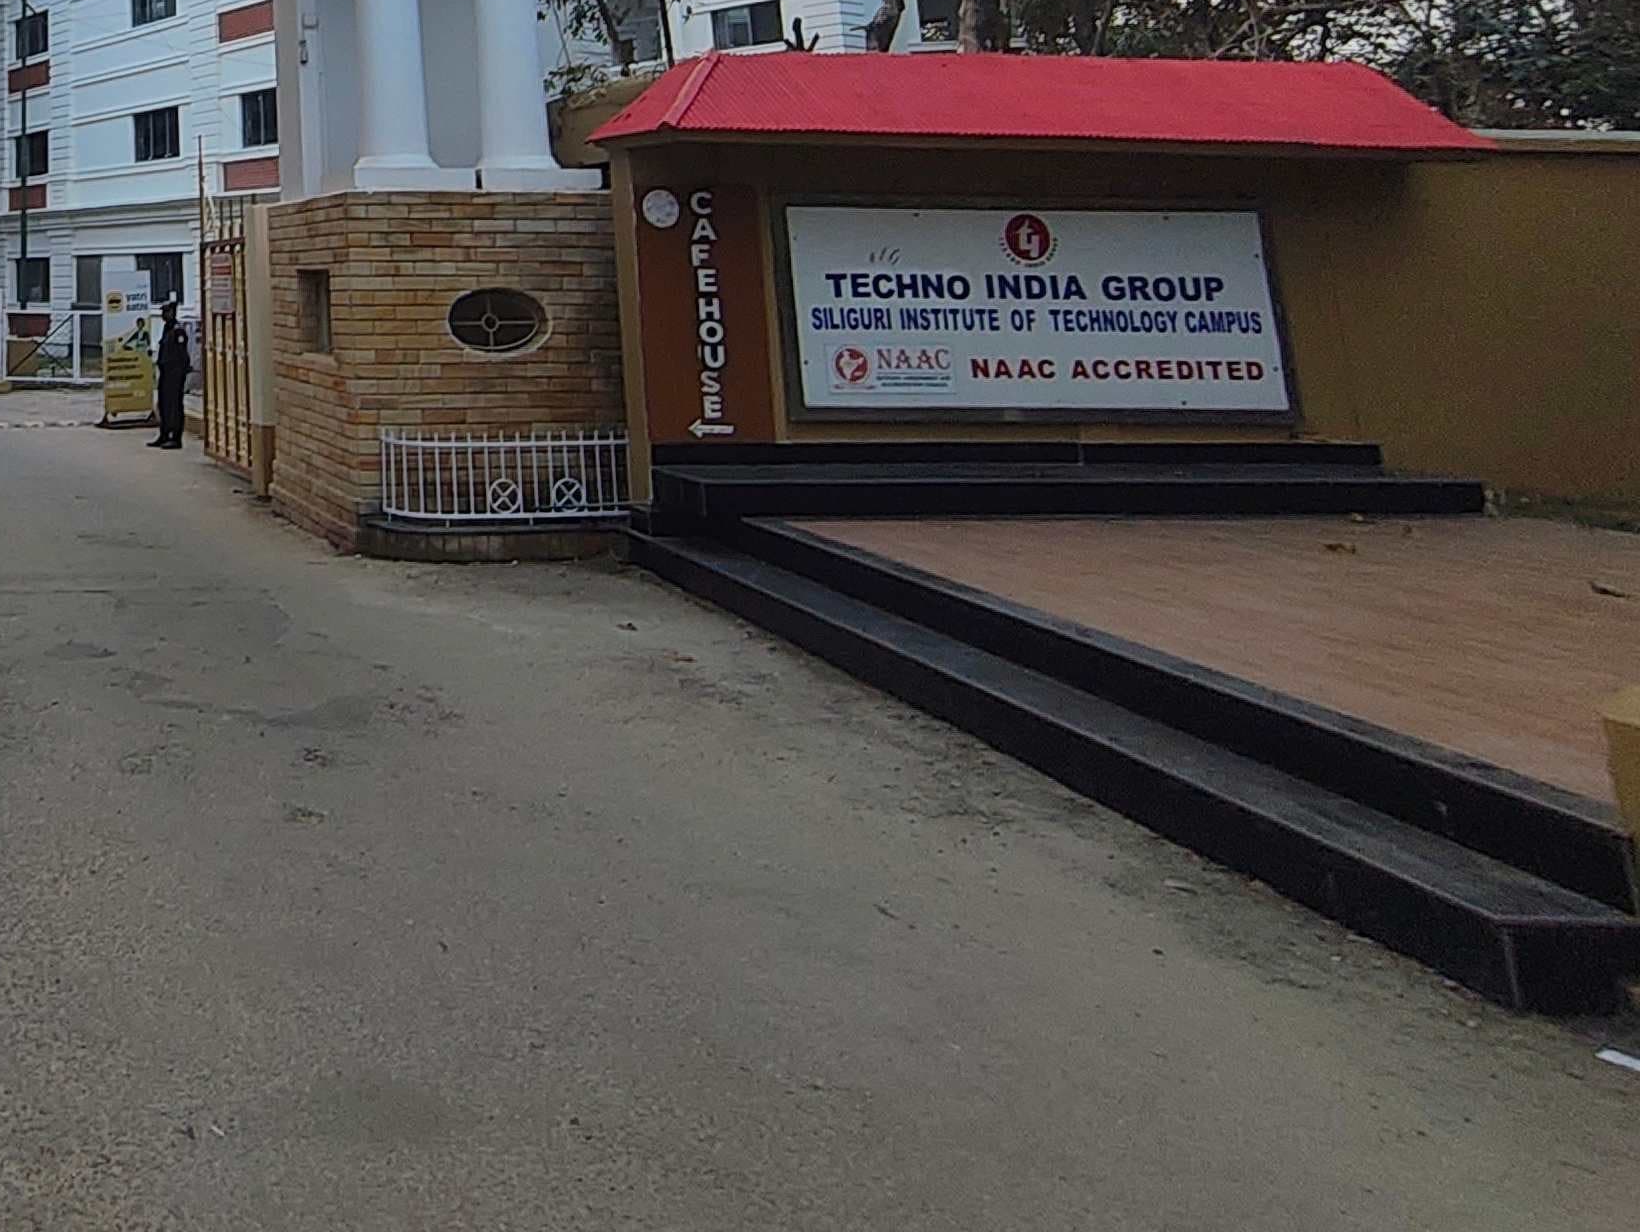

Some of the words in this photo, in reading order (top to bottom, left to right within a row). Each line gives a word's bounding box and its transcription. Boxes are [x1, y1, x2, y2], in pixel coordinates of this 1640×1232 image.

[825, 273, 971, 300] TECHNO
[985, 275, 1087, 300] INDIA
[1101, 276, 1224, 302] GROUP
[811, 308, 892, 331] SILIGURI
[900, 309, 1000, 332] INSTITUTE
[1012, 310, 1035, 331] OF
[1048, 310, 1178, 334] TECHNOLOGY
[1184, 312, 1262, 334] CAMPUS
[876, 349, 951, 370] NAAC
[970, 359, 1055, 379] NAAC
[1071, 360, 1264, 380] ACCREDITED
